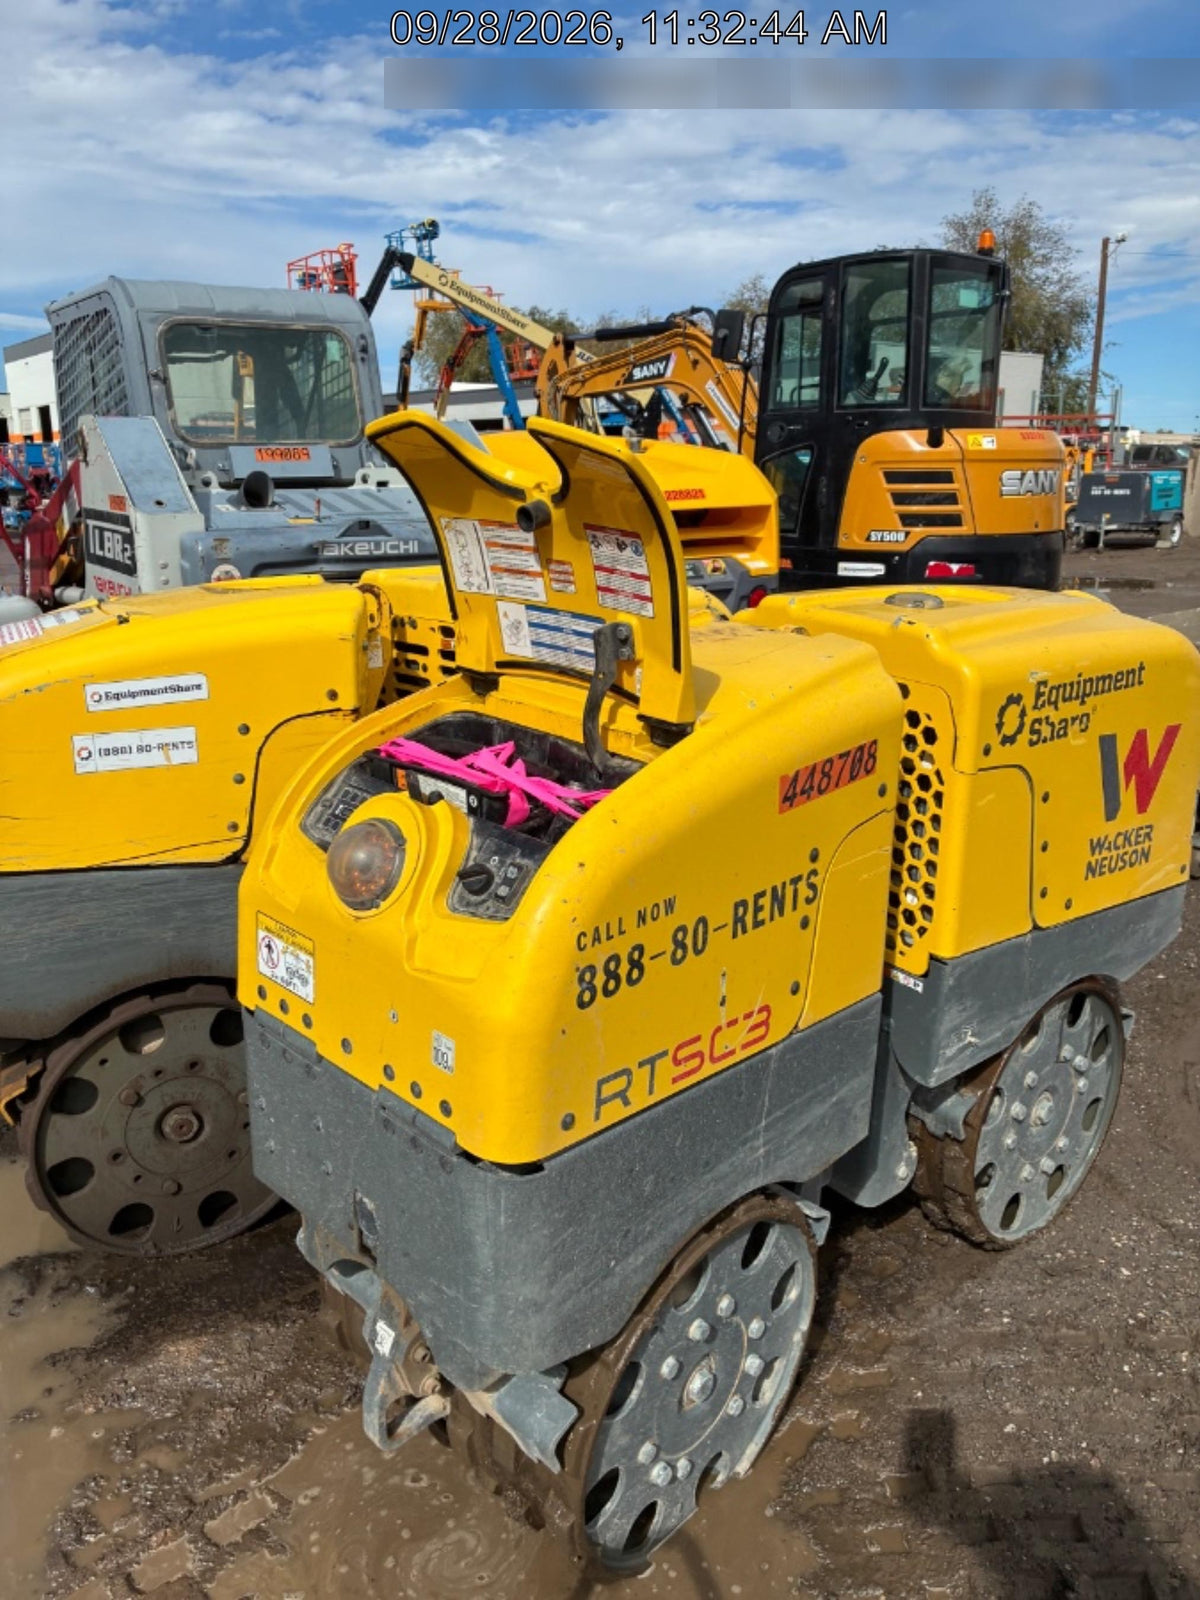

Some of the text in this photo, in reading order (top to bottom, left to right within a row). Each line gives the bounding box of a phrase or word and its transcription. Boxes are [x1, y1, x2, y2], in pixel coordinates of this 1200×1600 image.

[632, 361, 667, 380] SANY
[1000, 470, 1059, 496] SANY
[104, 682, 204, 703] EquipmentShare
[1032, 661, 1146, 711] Equipment
[780, 738, 878, 808] 448708
[1084, 845, 1152, 881] NEUSON
[575, 895, 678, 952] CALL NOW
[576, 868, 819, 1011] 888-80-RENTS
[594, 1004, 772, 1123] RTSC3
